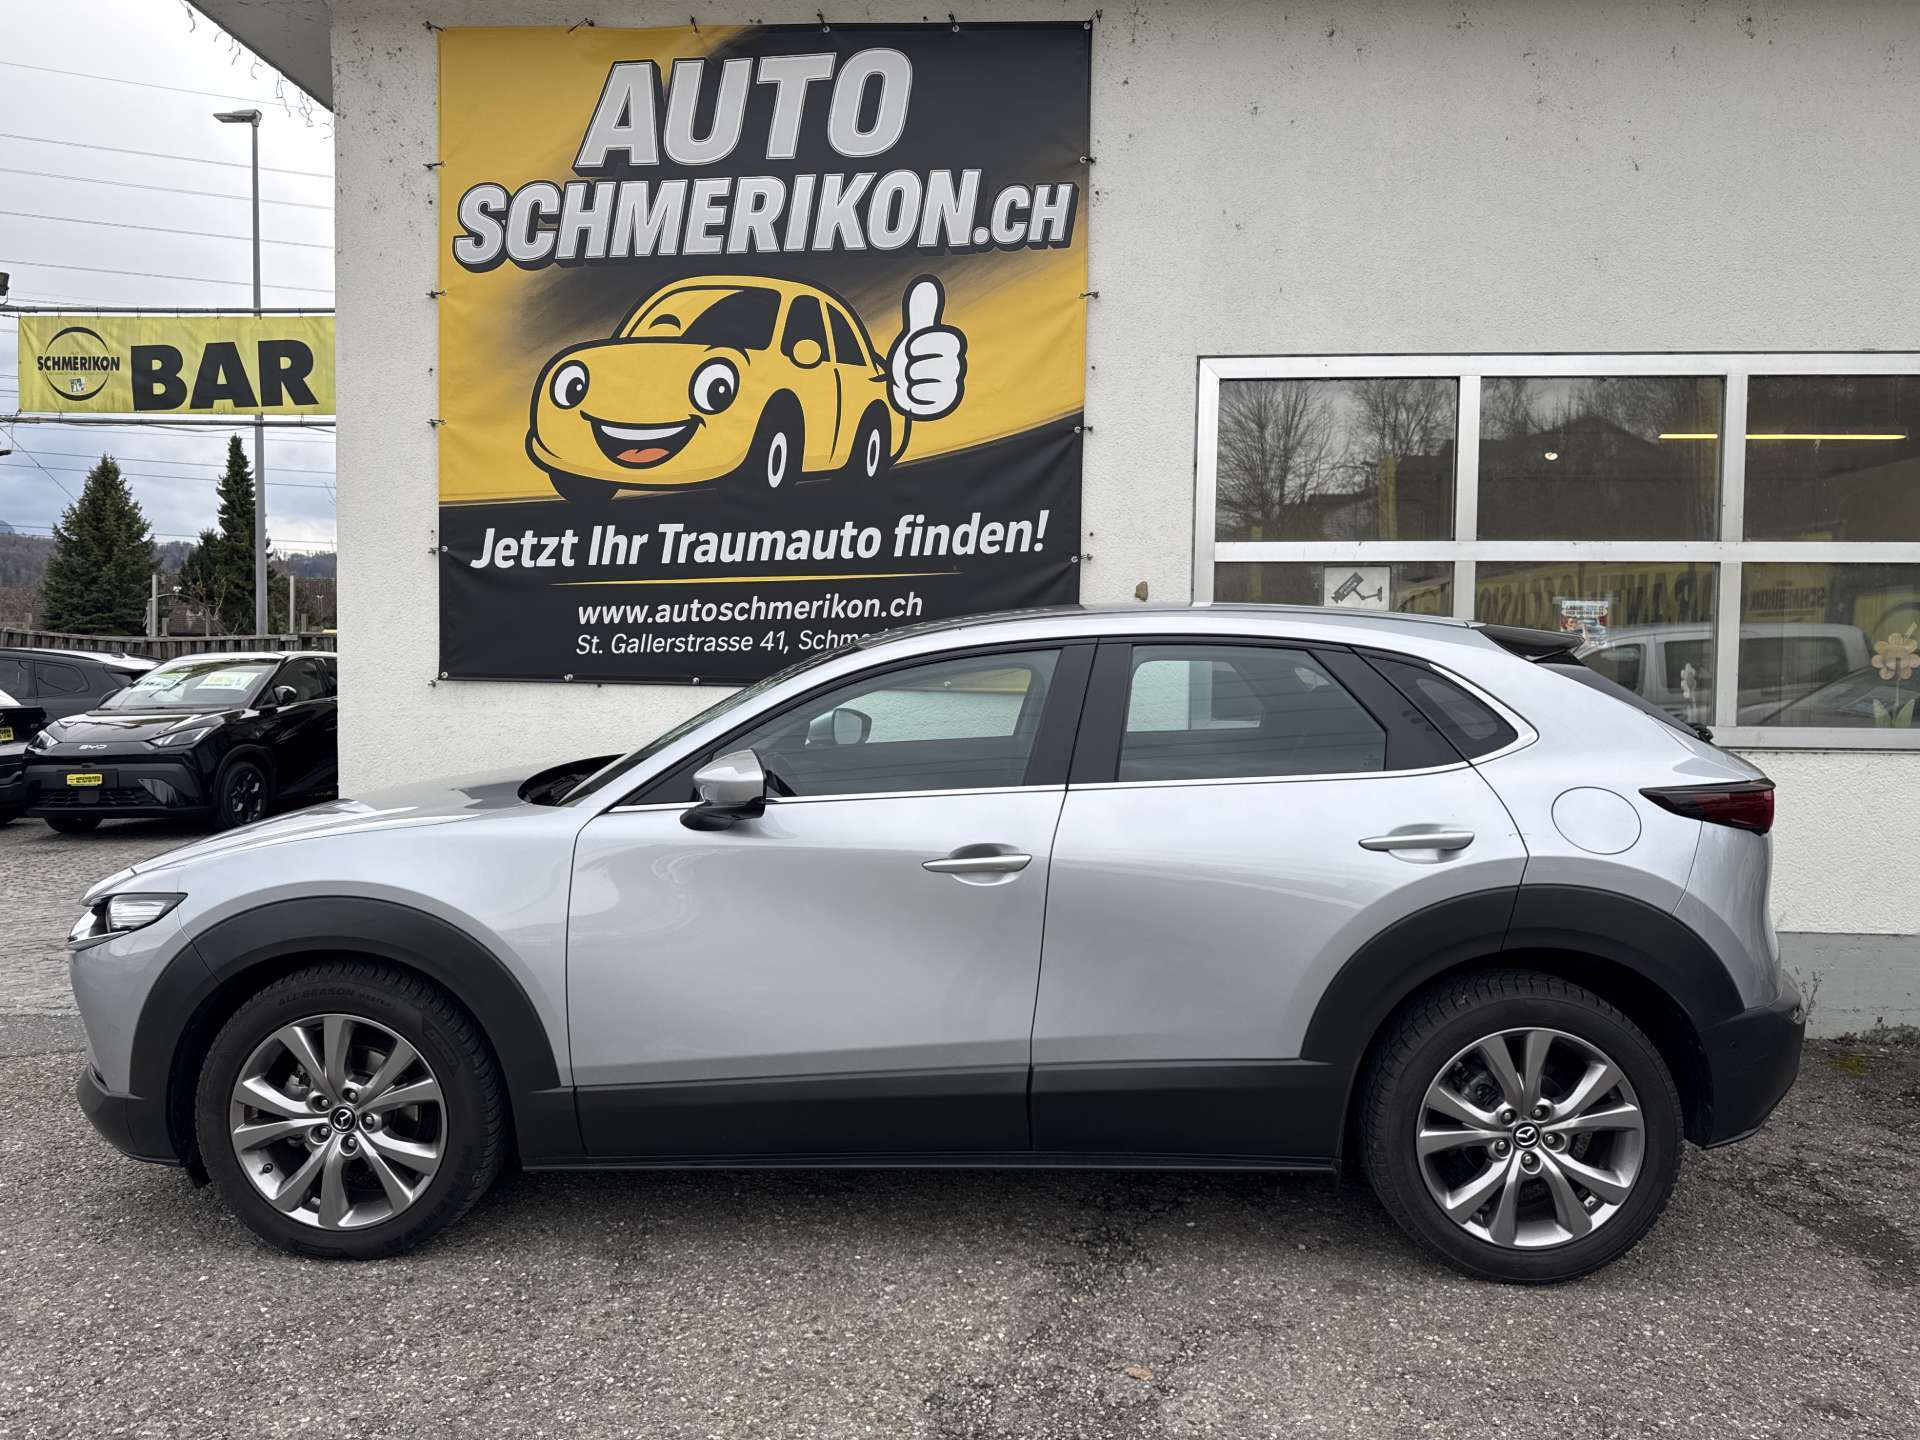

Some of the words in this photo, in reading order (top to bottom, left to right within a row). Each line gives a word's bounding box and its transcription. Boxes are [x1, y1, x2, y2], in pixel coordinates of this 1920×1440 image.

[574, 47, 912, 168] AUTO
[453, 168, 1074, 264] SCHMERIKON.CH
[37, 355, 120, 371] SCHMERIKON
[130, 339, 320, 411] BAR
[470, 527, 579, 569] Jetzt
[588, 524, 649, 566] Ihr
[658, 520, 882, 564] Traumauto
[893, 509, 1050, 557] finden!
[578, 591, 923, 625] www.autoschmerikon.ch
[575, 633, 603, 655] St.
[610, 632, 753, 654] Gallerstrasse
[759, 630, 789, 655] 41,
[798, 628, 871, 650] Schm
